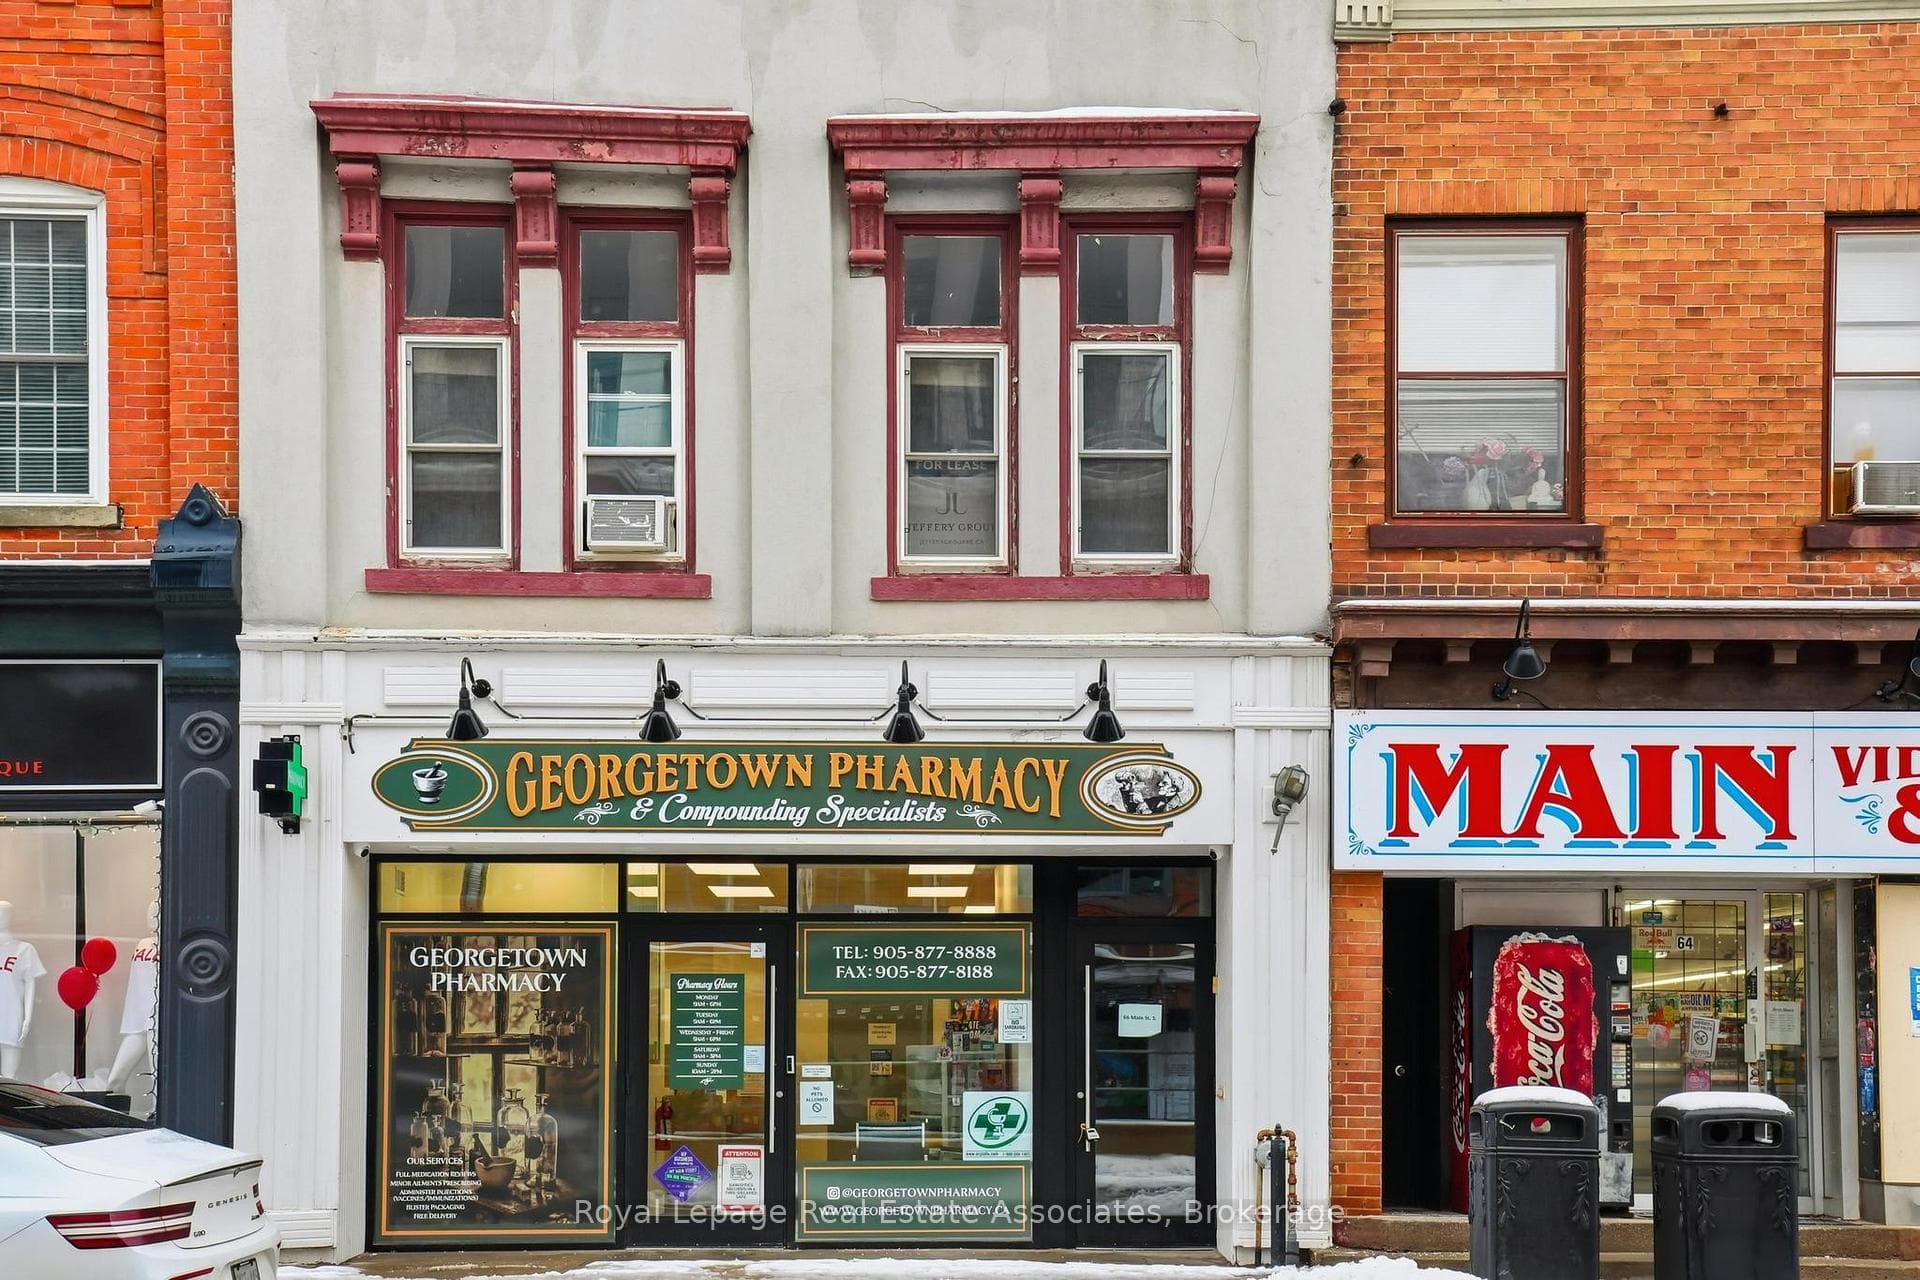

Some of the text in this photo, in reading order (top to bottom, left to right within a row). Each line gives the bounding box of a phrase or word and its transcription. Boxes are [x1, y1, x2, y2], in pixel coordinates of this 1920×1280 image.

[505, 751, 1070, 818] GEORGETOWN PHARMACY
[1379, 743, 1798, 848] MAIN
[630, 793, 947, 827] & Compounding Specialists
[1677, 936, 1693, 949] 64
[410, 946, 586, 968] GEORGETOWN
[832, 945, 997, 959] TEL: 905-877-8888
[836, 965, 993, 979] FAX: 905-877-8188
[431, 972, 567, 992] PHARMACY
[677, 978, 738, 990] Pharmacy Hours
[406, 1157, 464, 1165] OUR SERVICES
[842, 1187, 1002, 1199] @GEORGETOWNPHARMACY
[208, 1193, 248, 1209] GENESIS
